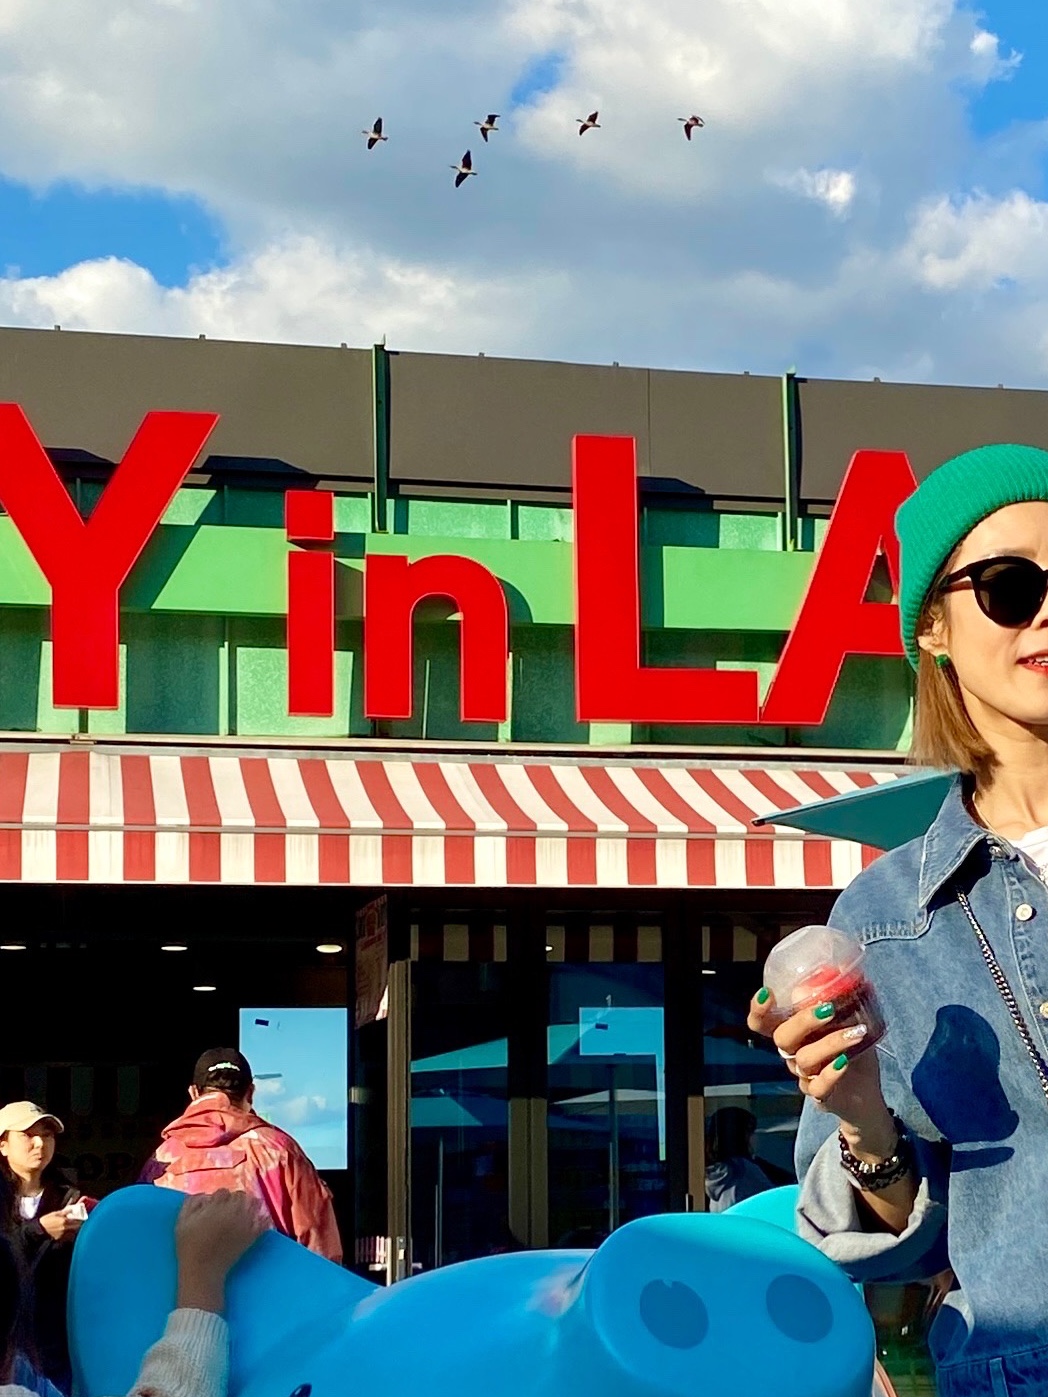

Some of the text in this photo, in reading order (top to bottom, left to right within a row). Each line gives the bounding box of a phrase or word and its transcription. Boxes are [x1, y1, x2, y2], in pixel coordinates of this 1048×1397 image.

[0, 403, 918, 724] Y in LA
